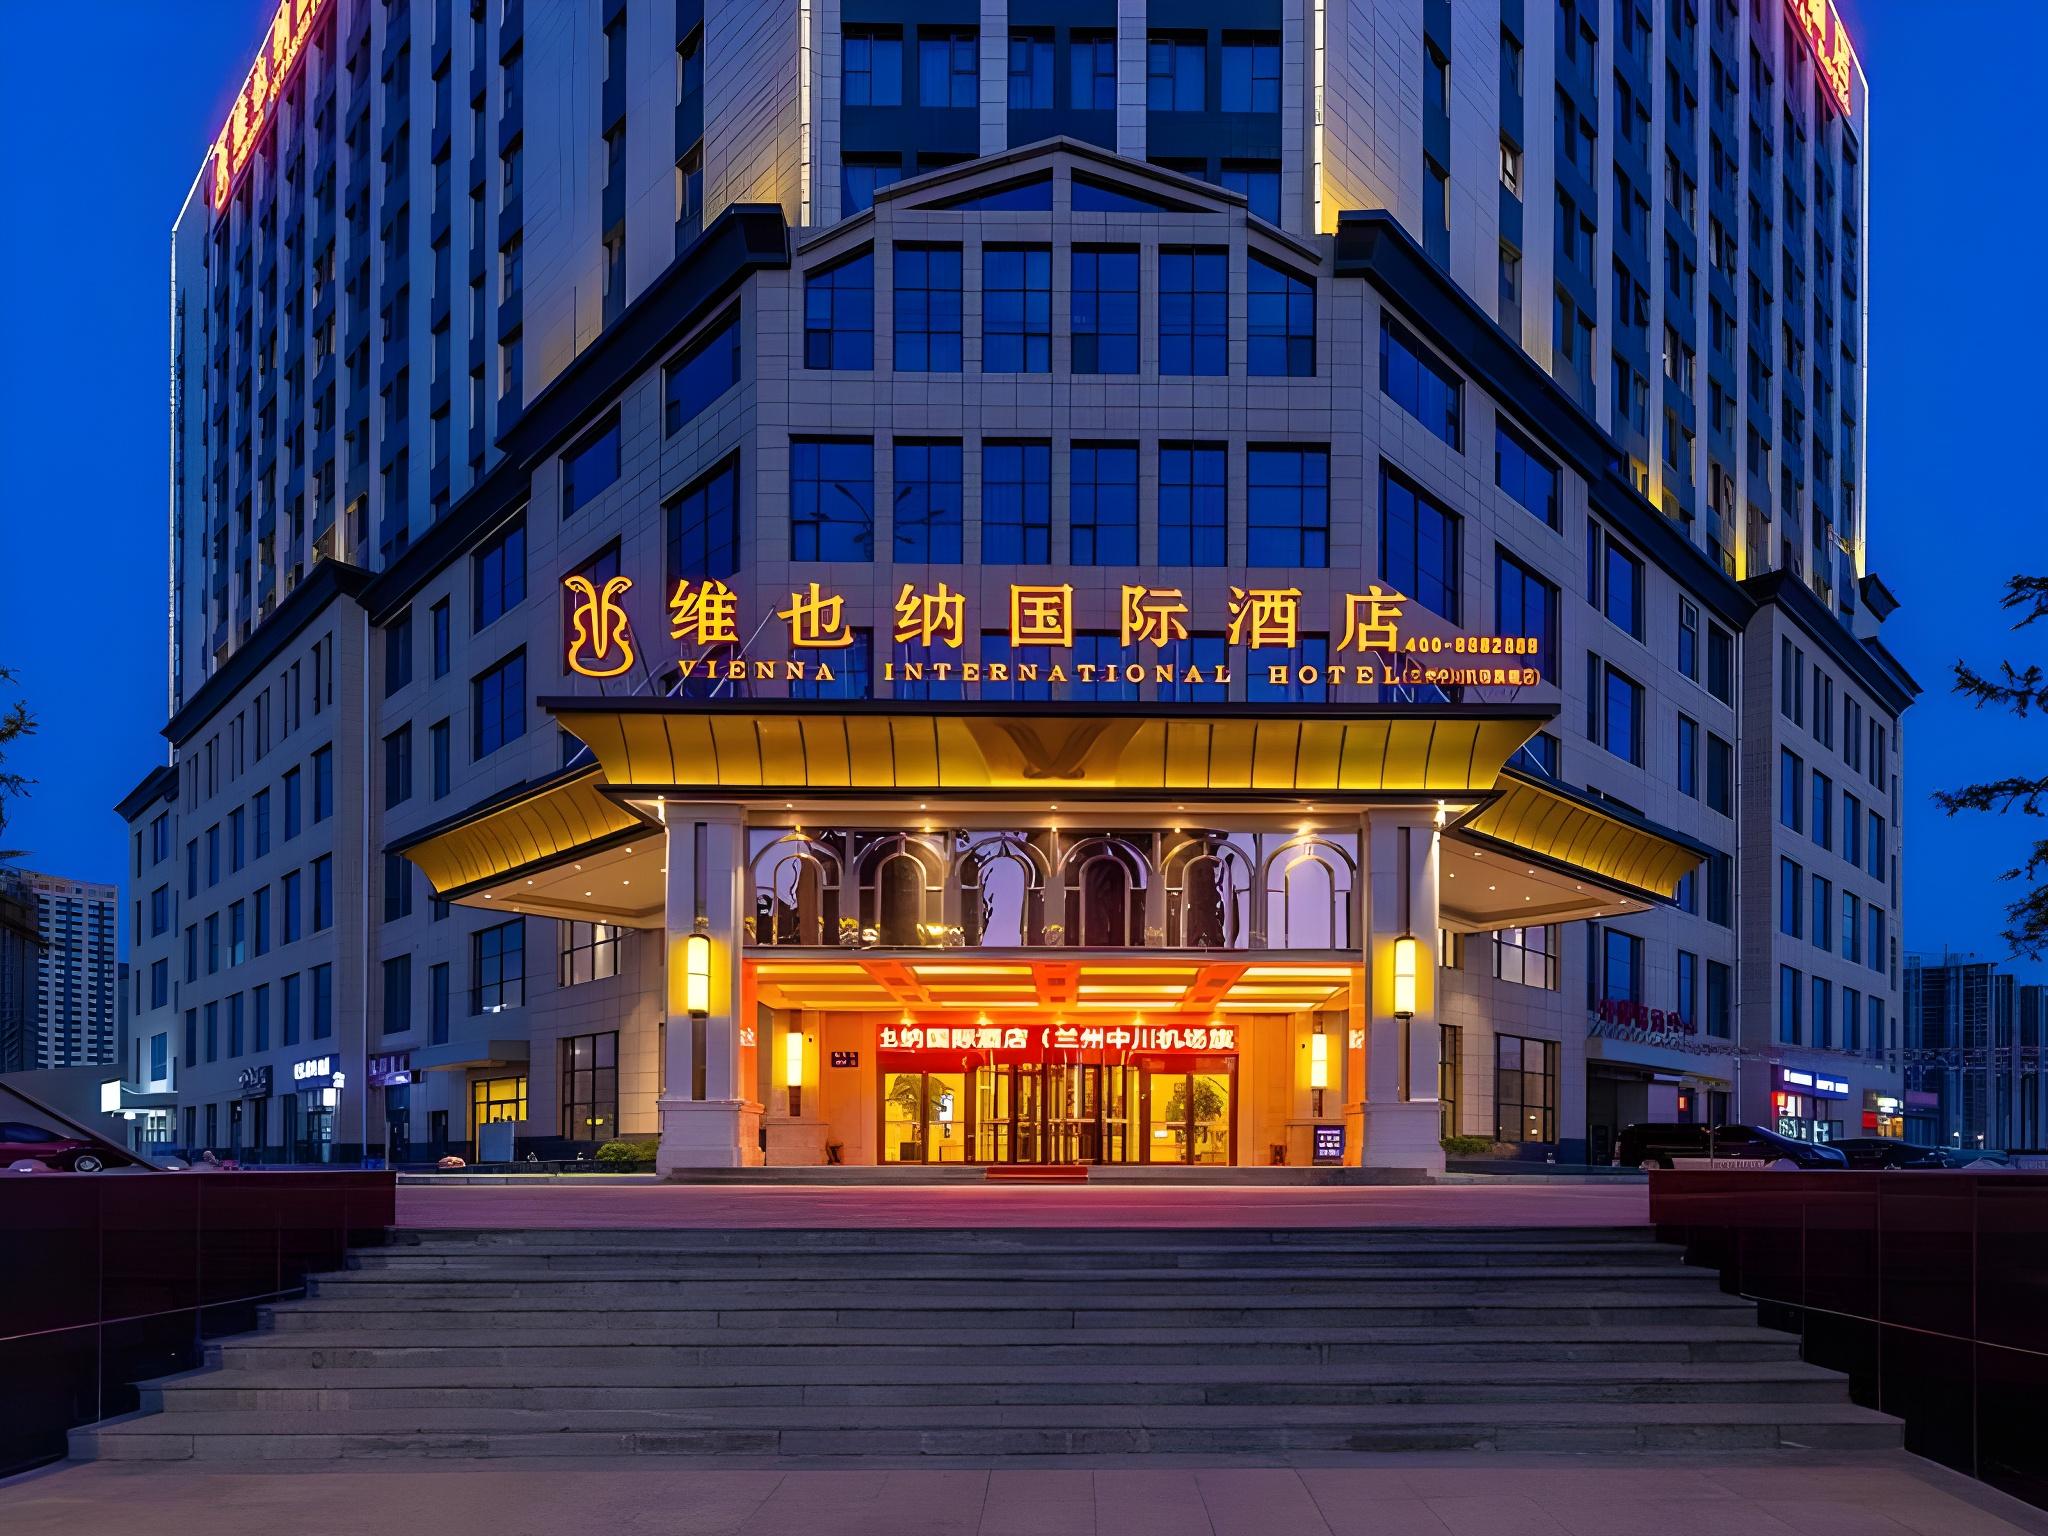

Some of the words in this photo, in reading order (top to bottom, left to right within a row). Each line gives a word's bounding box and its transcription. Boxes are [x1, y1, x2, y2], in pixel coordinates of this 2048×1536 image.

[669, 580, 1407, 653] 维也纳国际酒店
[678, 659, 836, 681] VIENNA
[884, 661, 1231, 684] INTERNATIONAL
[1268, 664, 1400, 685] HOTEL
